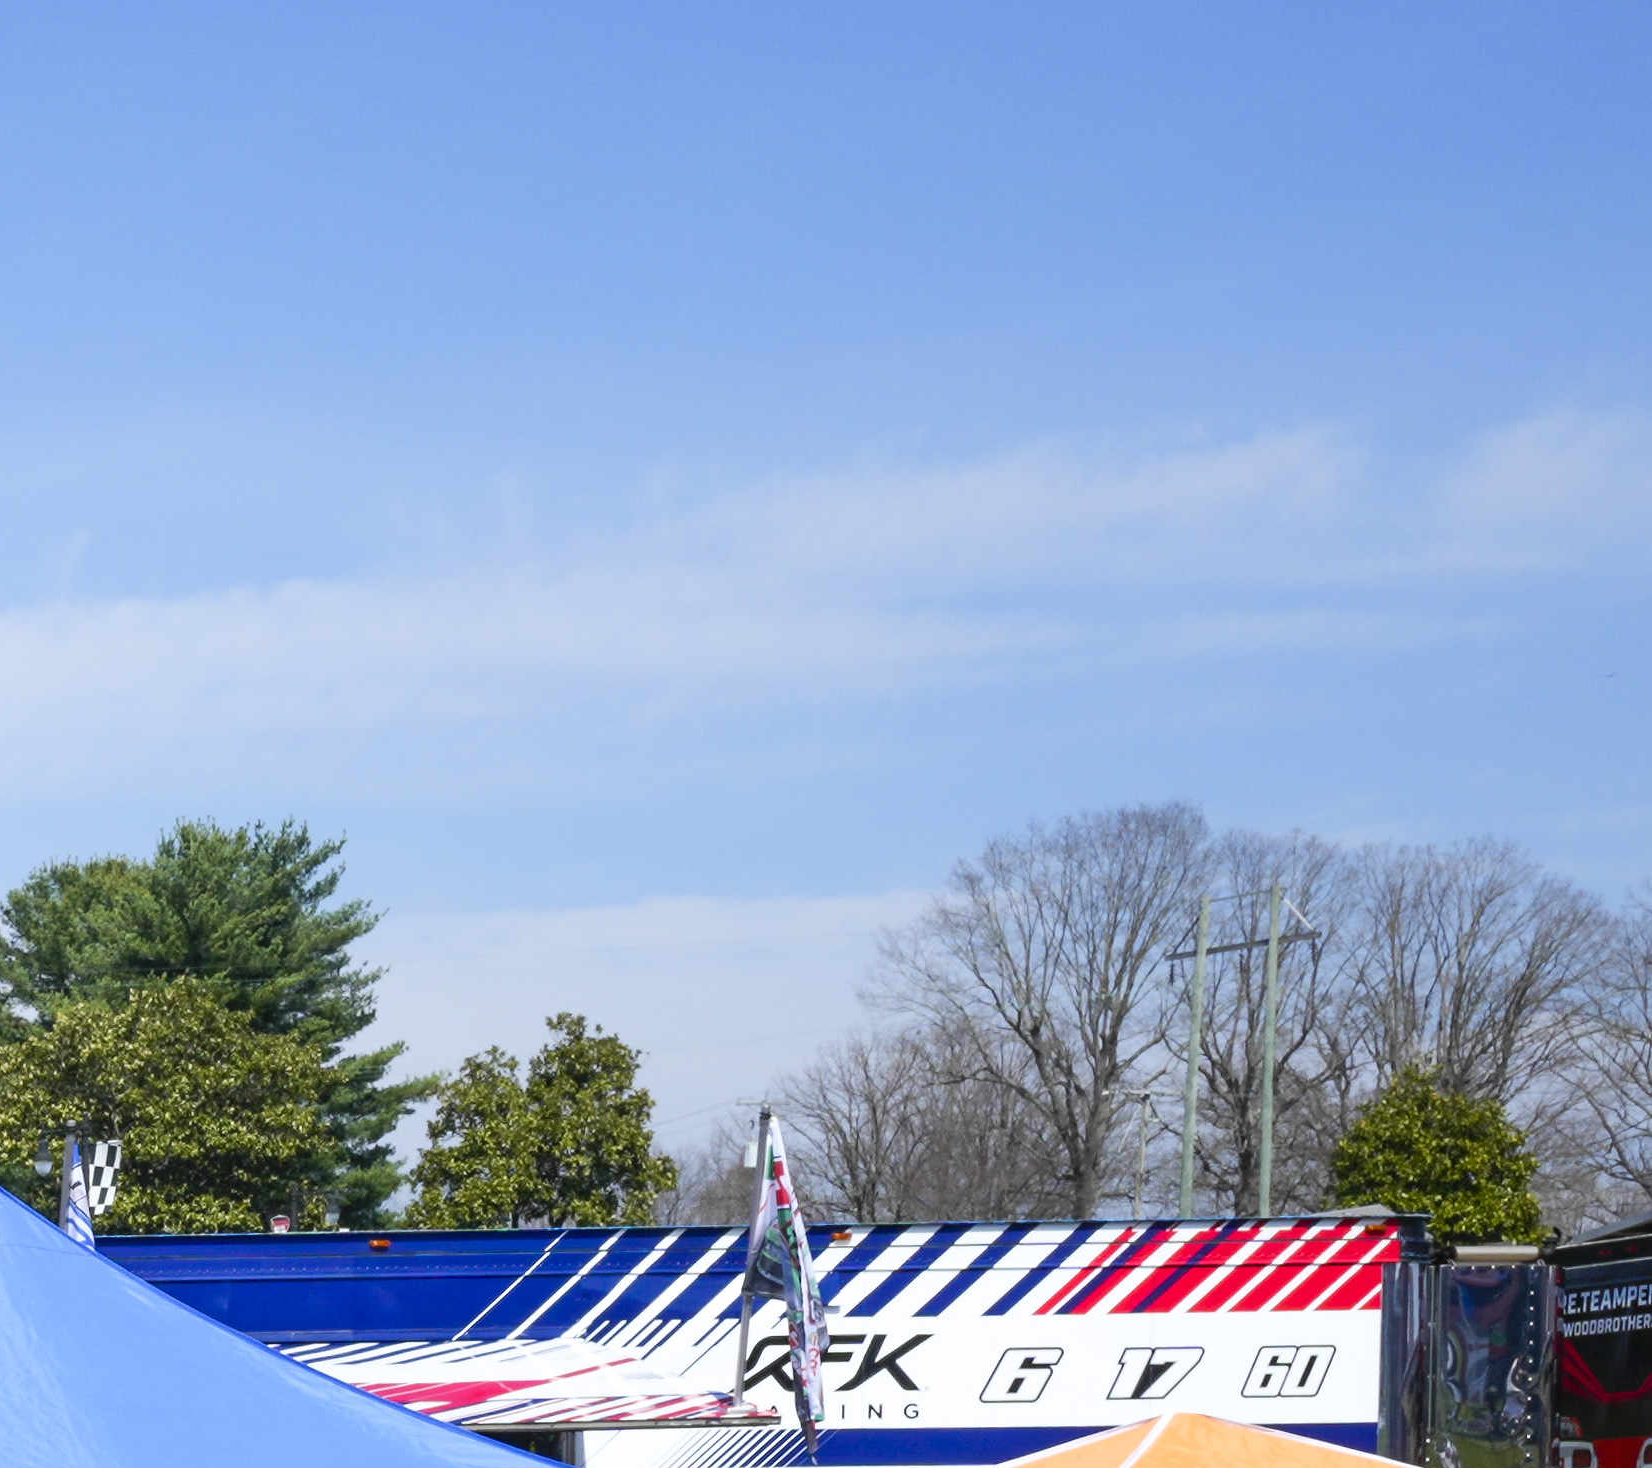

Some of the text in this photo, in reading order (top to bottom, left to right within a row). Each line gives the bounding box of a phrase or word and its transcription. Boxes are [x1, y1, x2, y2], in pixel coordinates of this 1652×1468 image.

[979, 1346, 1064, 1403] 6
[1108, 1346, 1205, 1400] 17
[1242, 1344, 1337, 1399] 60
